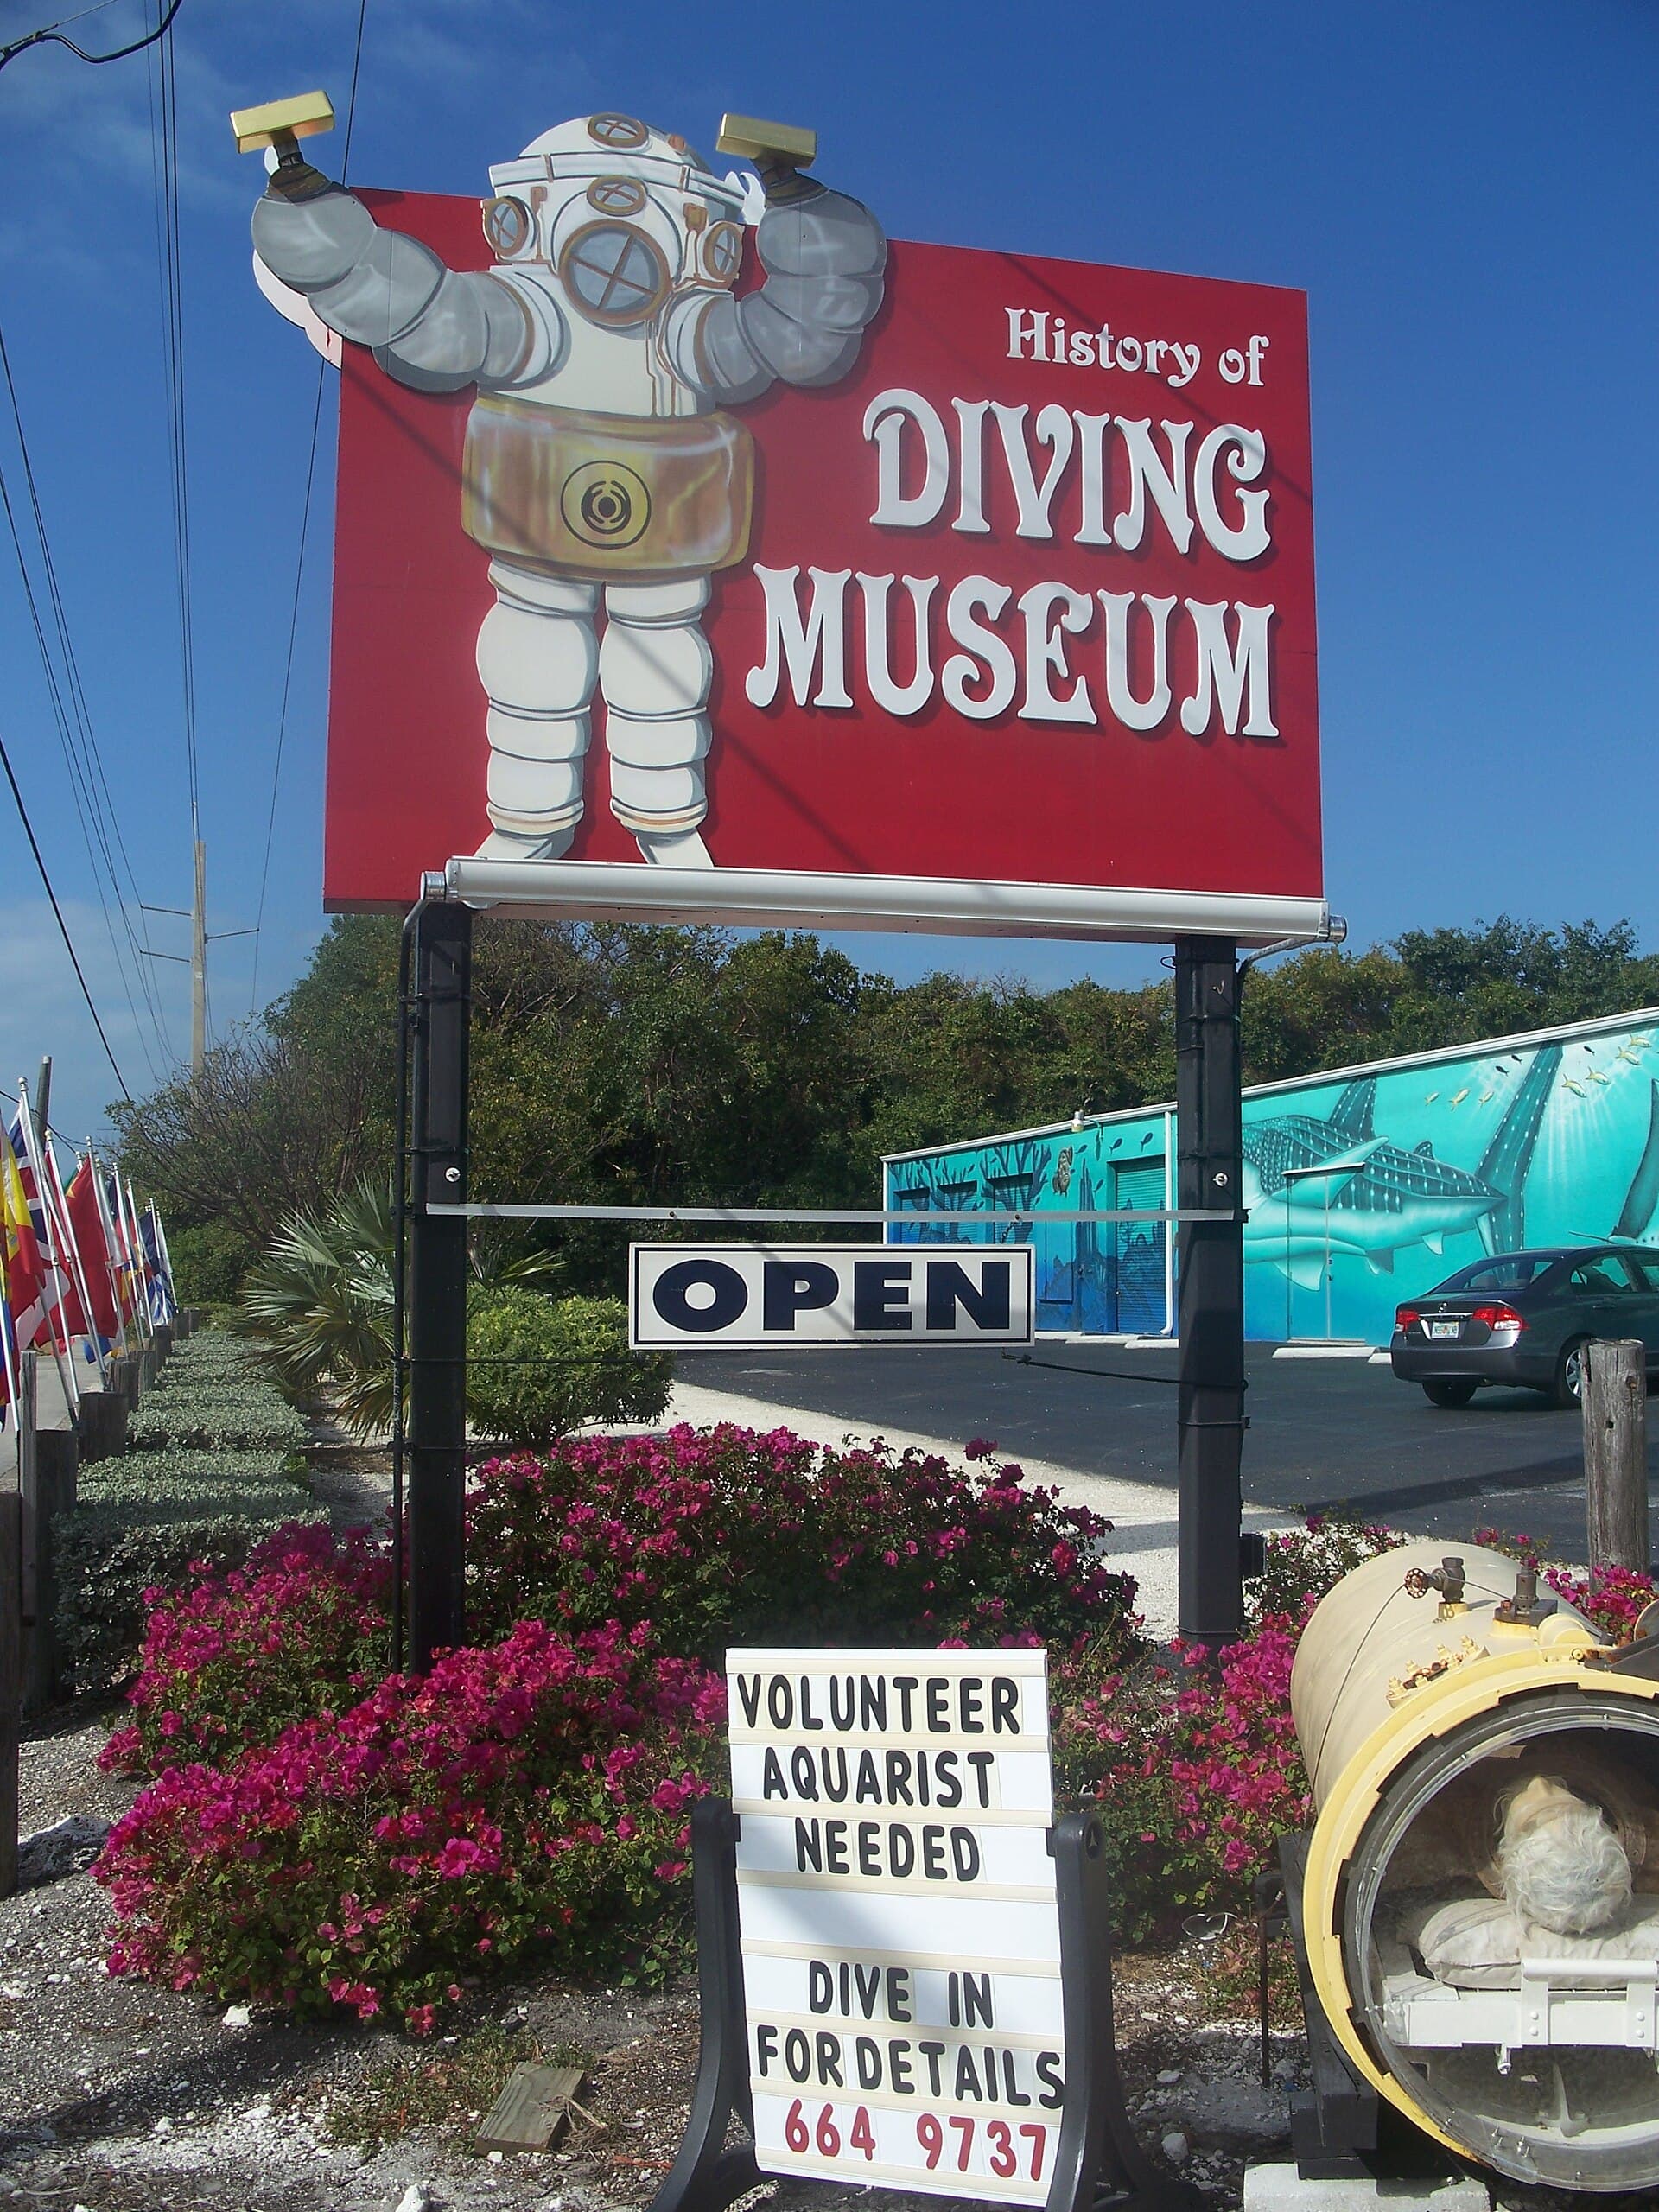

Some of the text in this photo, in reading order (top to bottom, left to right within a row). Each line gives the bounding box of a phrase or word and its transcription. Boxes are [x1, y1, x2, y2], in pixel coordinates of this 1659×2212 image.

[1004, 307, 1268, 387] History of
[863, 387, 1270, 562] DIVING
[745, 563, 1280, 737] MUSEUM
[652, 1259, 1010, 1332] OPEN
[737, 1674, 1020, 1735] VOLUNTEER
[764, 1746, 994, 1808] AQUARIST
[795, 1817, 980, 1882] NEEDED
[810, 1960, 993, 2029] DIVE IN
[785, 2099, 1046, 2182] 664 9737
